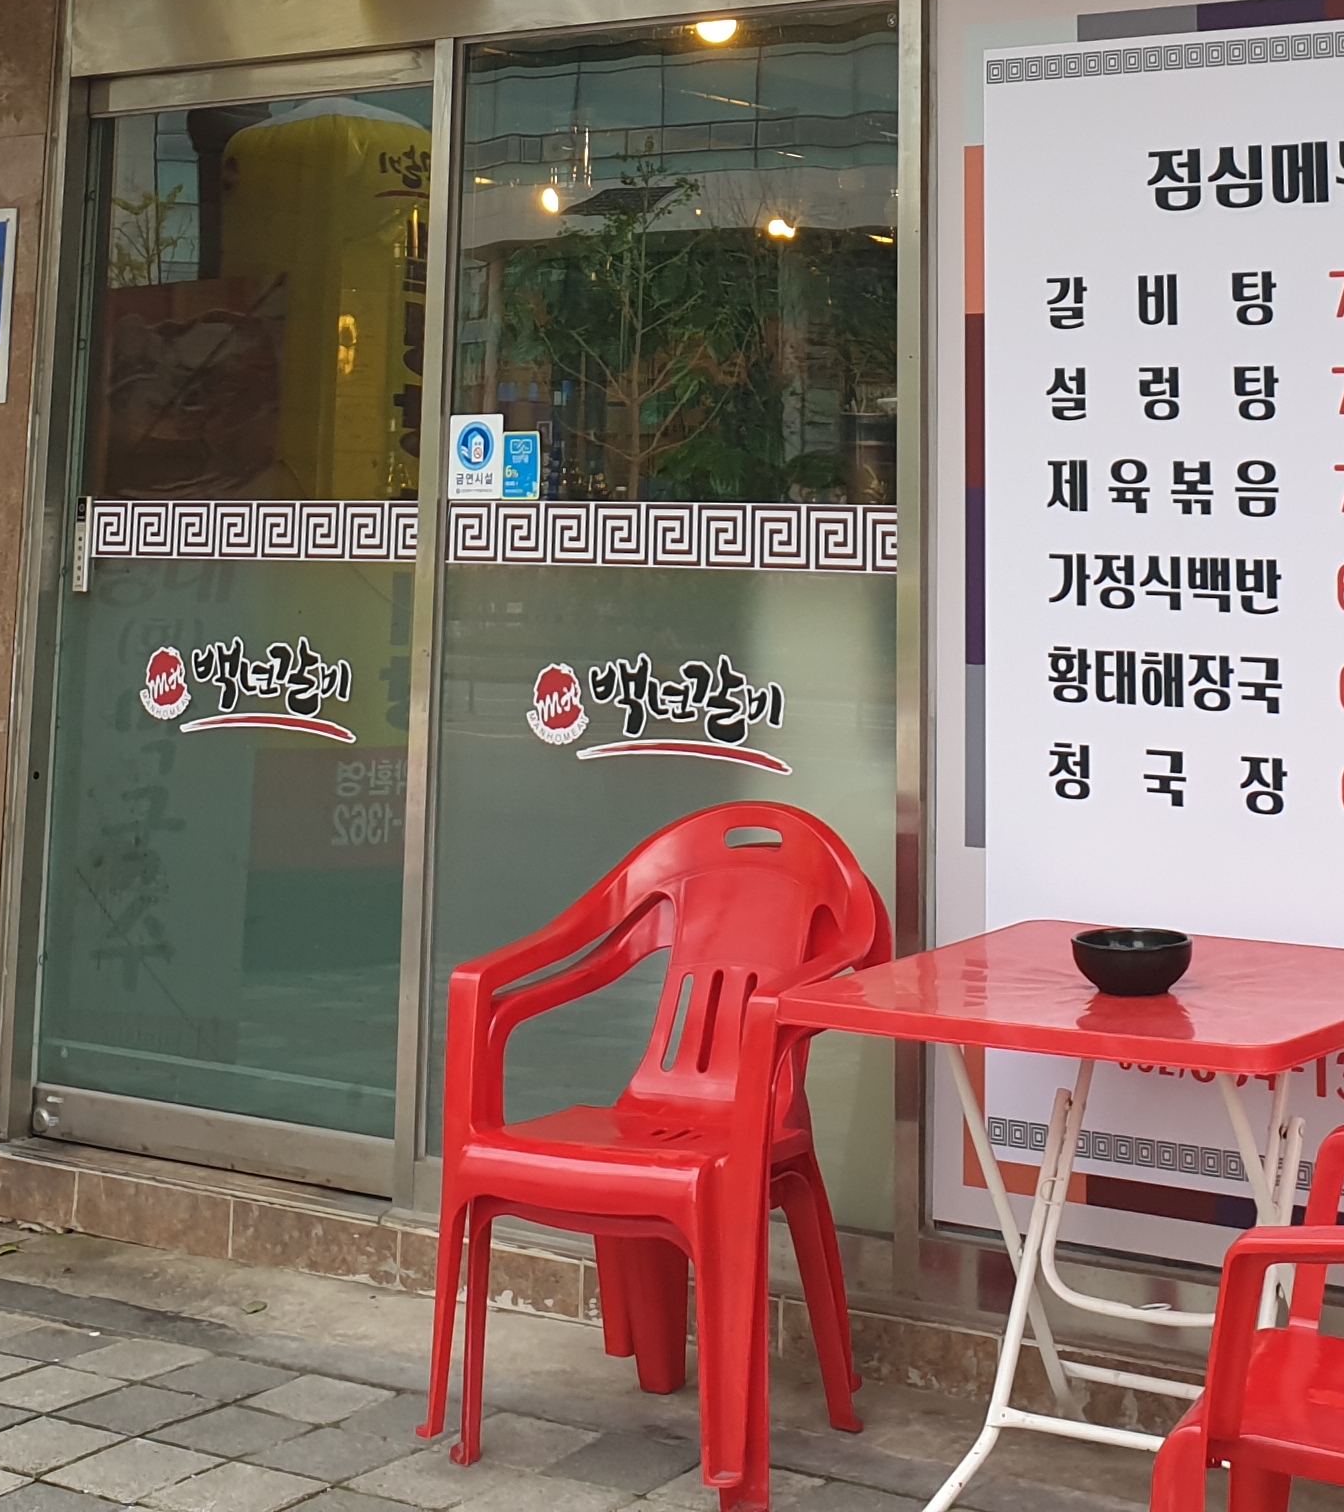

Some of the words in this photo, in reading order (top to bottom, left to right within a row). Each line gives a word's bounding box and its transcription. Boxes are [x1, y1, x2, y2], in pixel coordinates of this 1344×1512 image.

[456, 472, 493, 485] 금연시설
[1048, 552, 1282, 615] 가정식백반
[193, 637, 351, 716] 백년갈비
[589, 653, 784, 745] 백년갈비
[1047, 645, 1283, 715] 황태해장국
